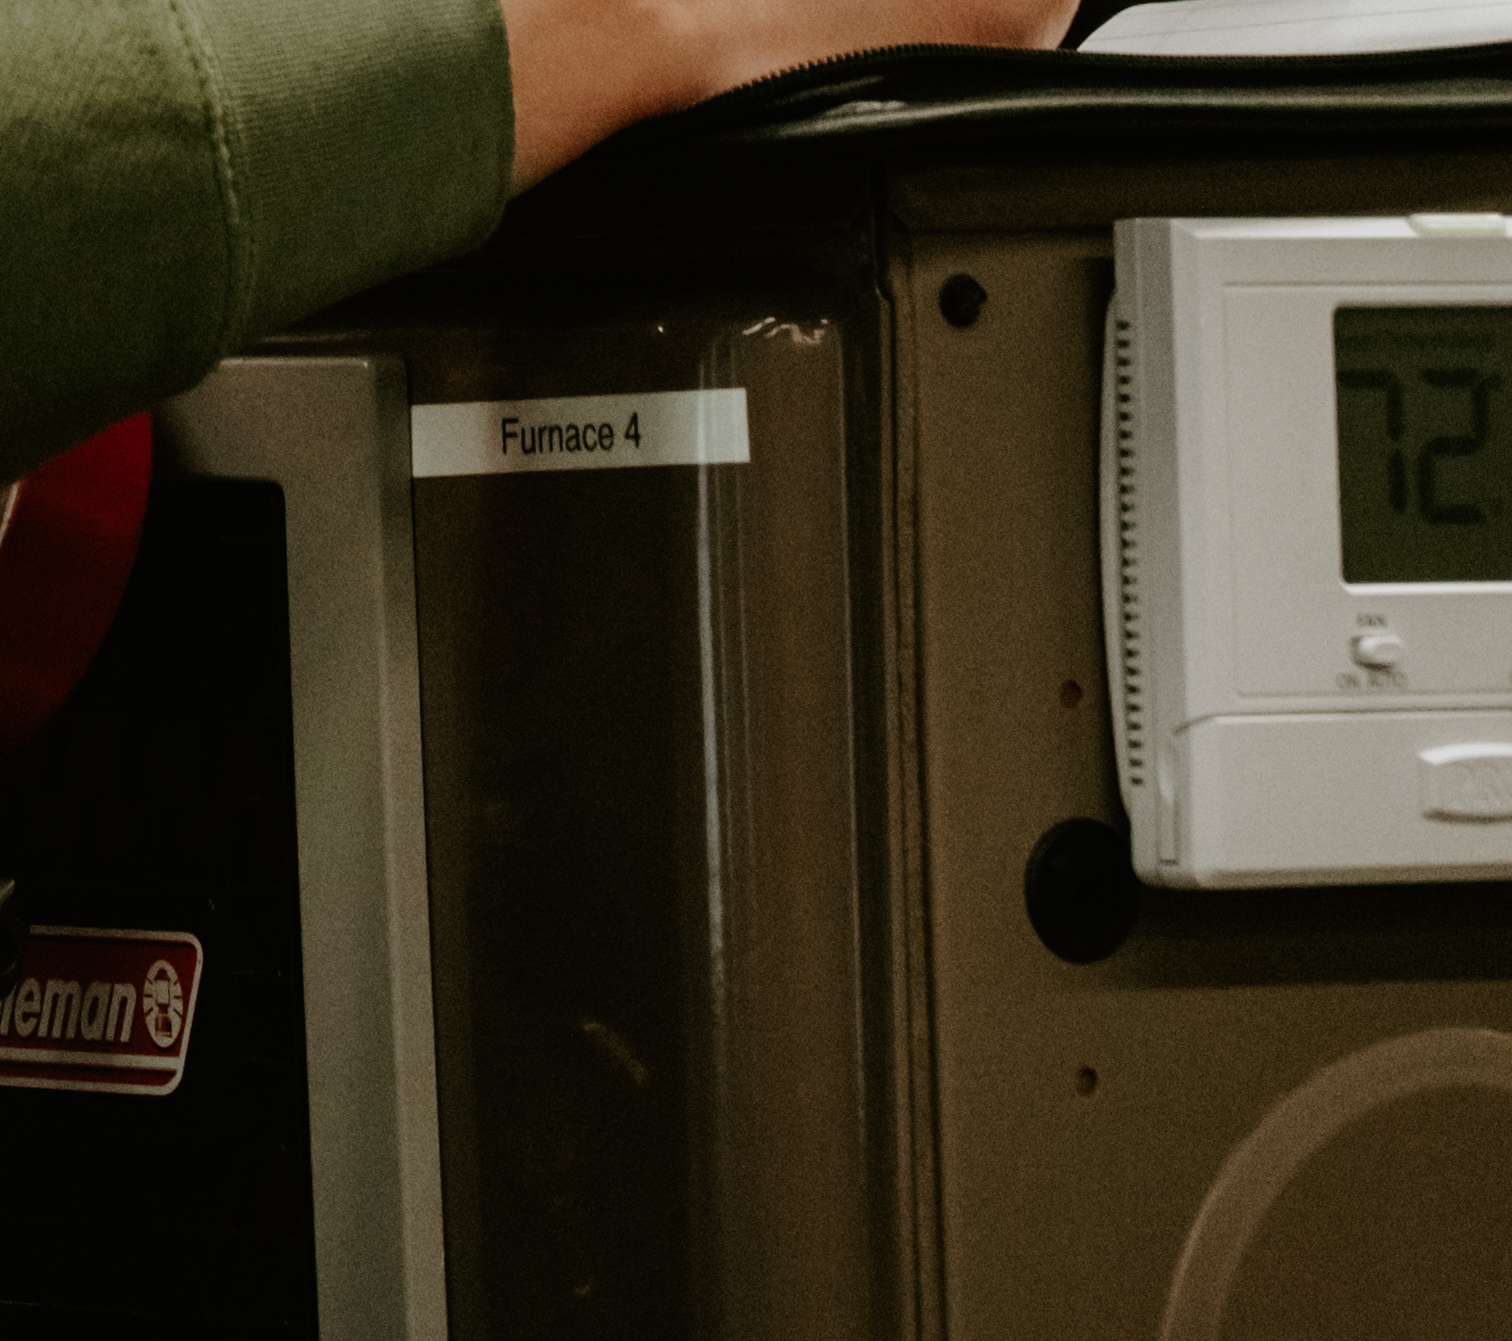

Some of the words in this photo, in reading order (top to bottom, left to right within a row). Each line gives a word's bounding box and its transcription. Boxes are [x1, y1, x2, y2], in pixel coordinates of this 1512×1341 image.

[501, 417, 615, 455] Furnace
[625, 412, 642, 449] 4
[1336, 367, 1489, 525] 72
